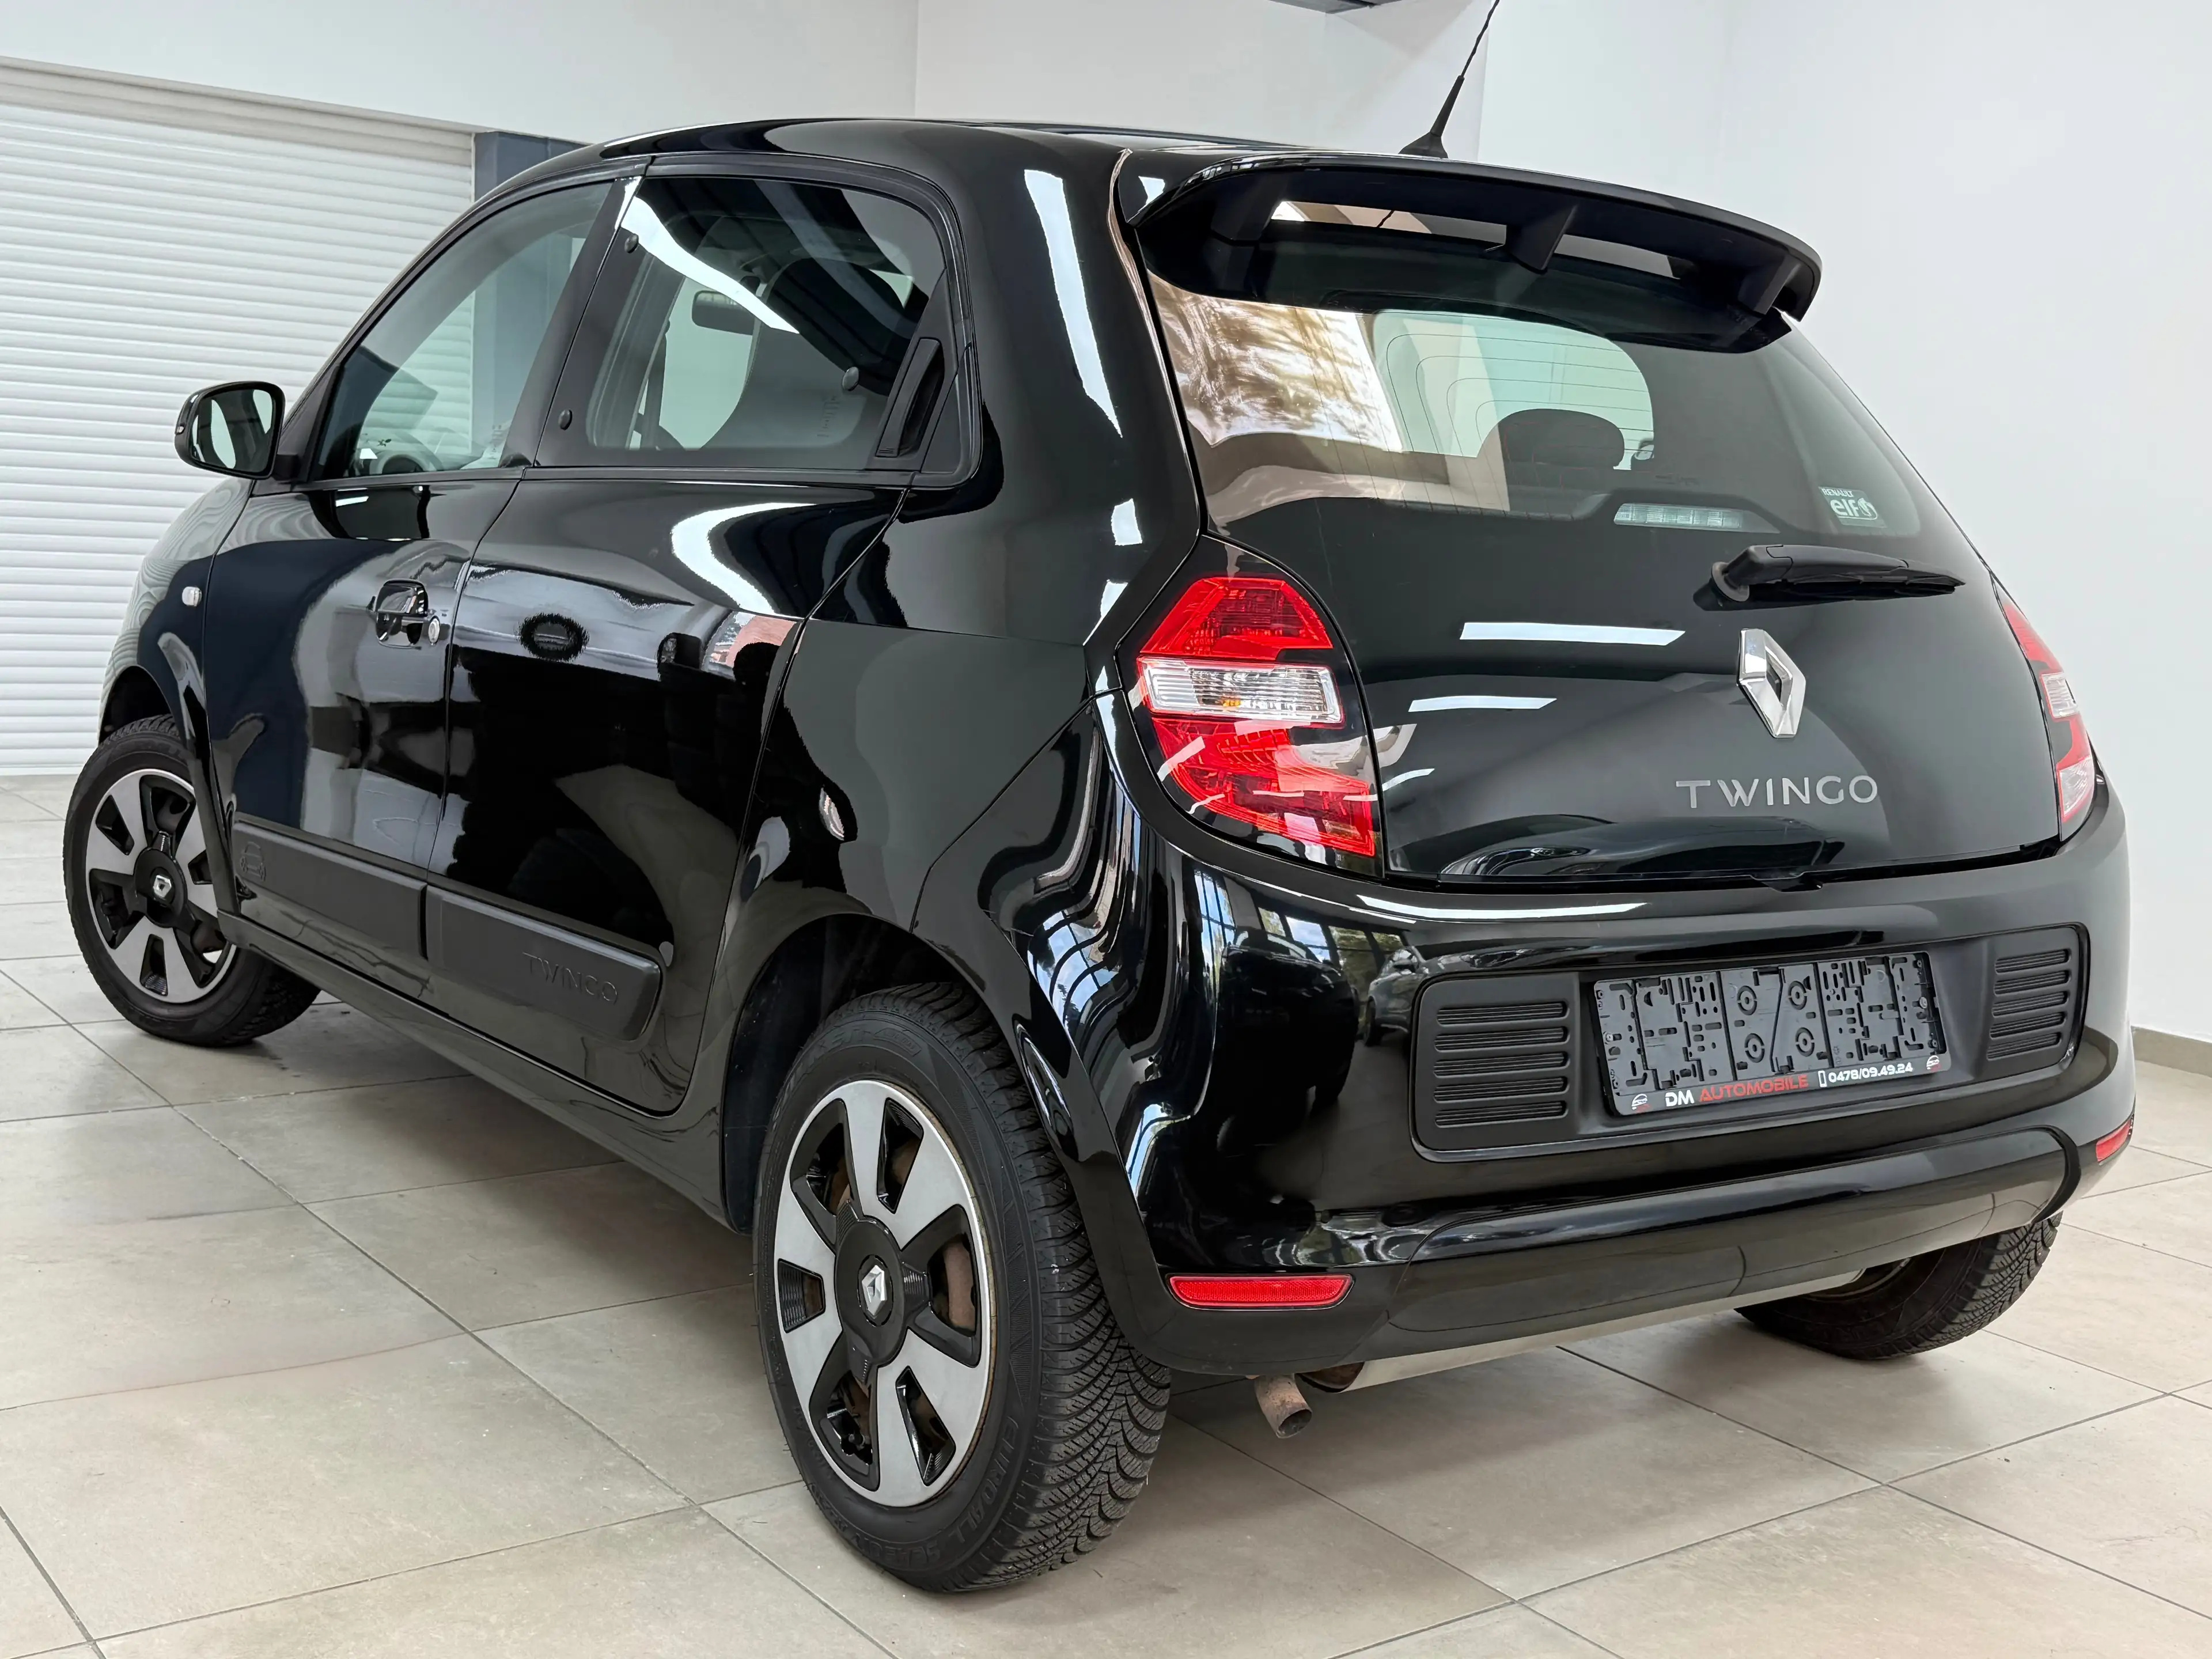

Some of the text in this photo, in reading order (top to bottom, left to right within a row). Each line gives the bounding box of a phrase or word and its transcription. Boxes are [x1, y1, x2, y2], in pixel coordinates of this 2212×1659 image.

[1821, 488, 1854, 498] RENAULT
[1676, 775, 1878, 808] TWINGO
[522, 952, 619, 1005] TWINGO
[1665, 1062, 1914, 1108] DM AUTOMOBILE 0478/09.49.24
